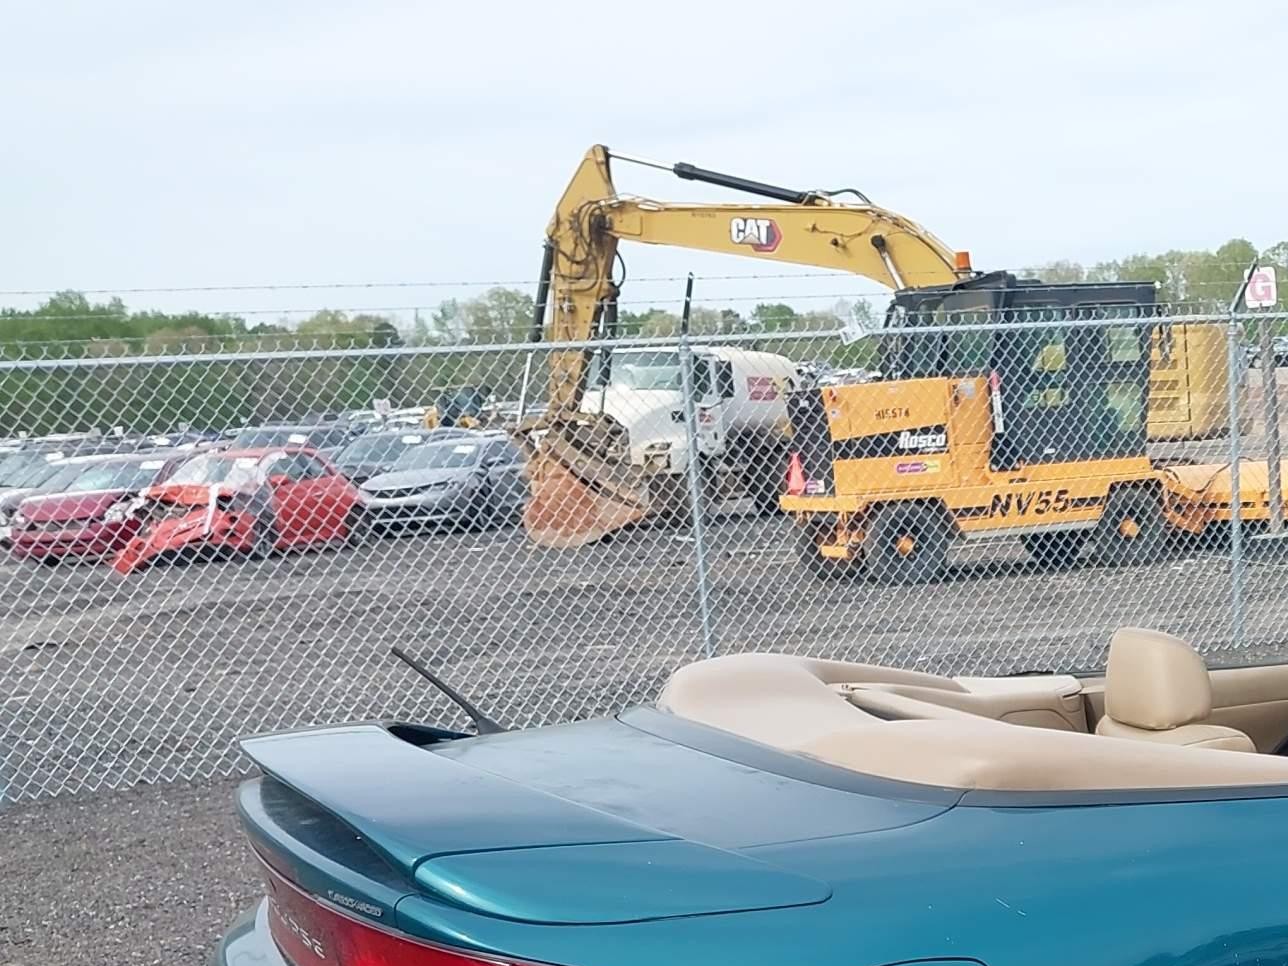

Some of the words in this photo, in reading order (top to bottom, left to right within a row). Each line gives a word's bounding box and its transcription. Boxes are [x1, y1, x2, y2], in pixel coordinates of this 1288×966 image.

[731, 217, 770, 245] CAT
[1250, 273, 1272, 301] G
[898, 431, 947, 449] Rosco
[989, 488, 1069, 519] NV55
